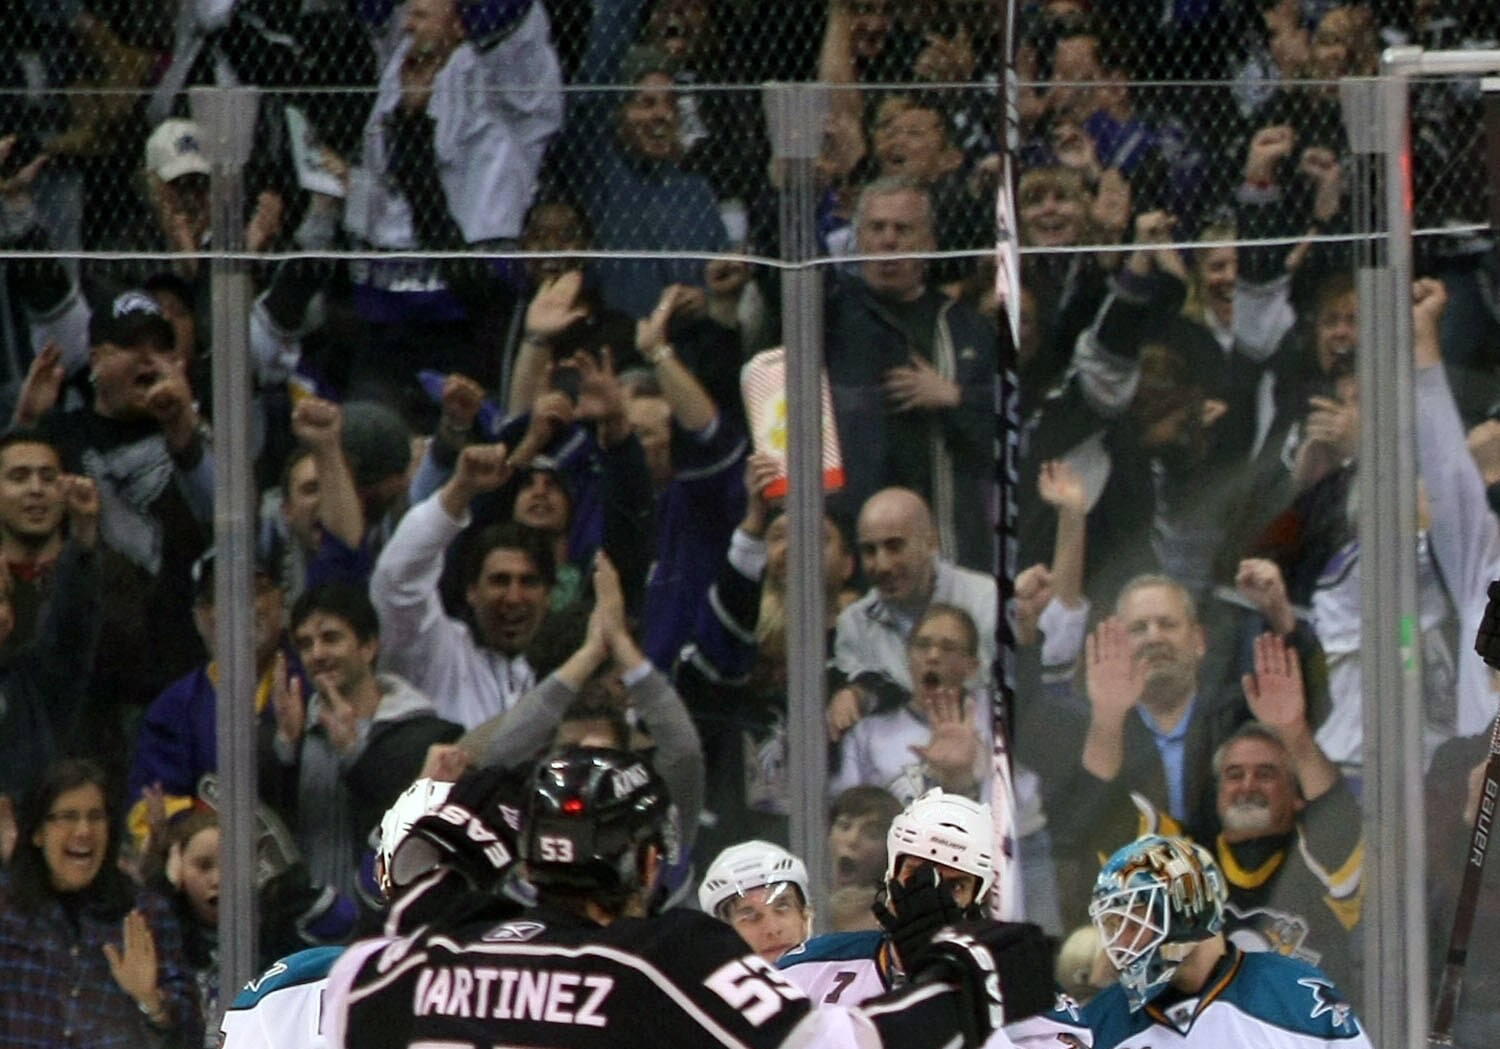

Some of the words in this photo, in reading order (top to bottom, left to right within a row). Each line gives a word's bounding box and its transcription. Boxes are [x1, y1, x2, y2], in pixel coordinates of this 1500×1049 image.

[1470, 778, 1499, 868] BAUER
[539, 836, 574, 863] 53
[824, 971, 858, 1004] 7
